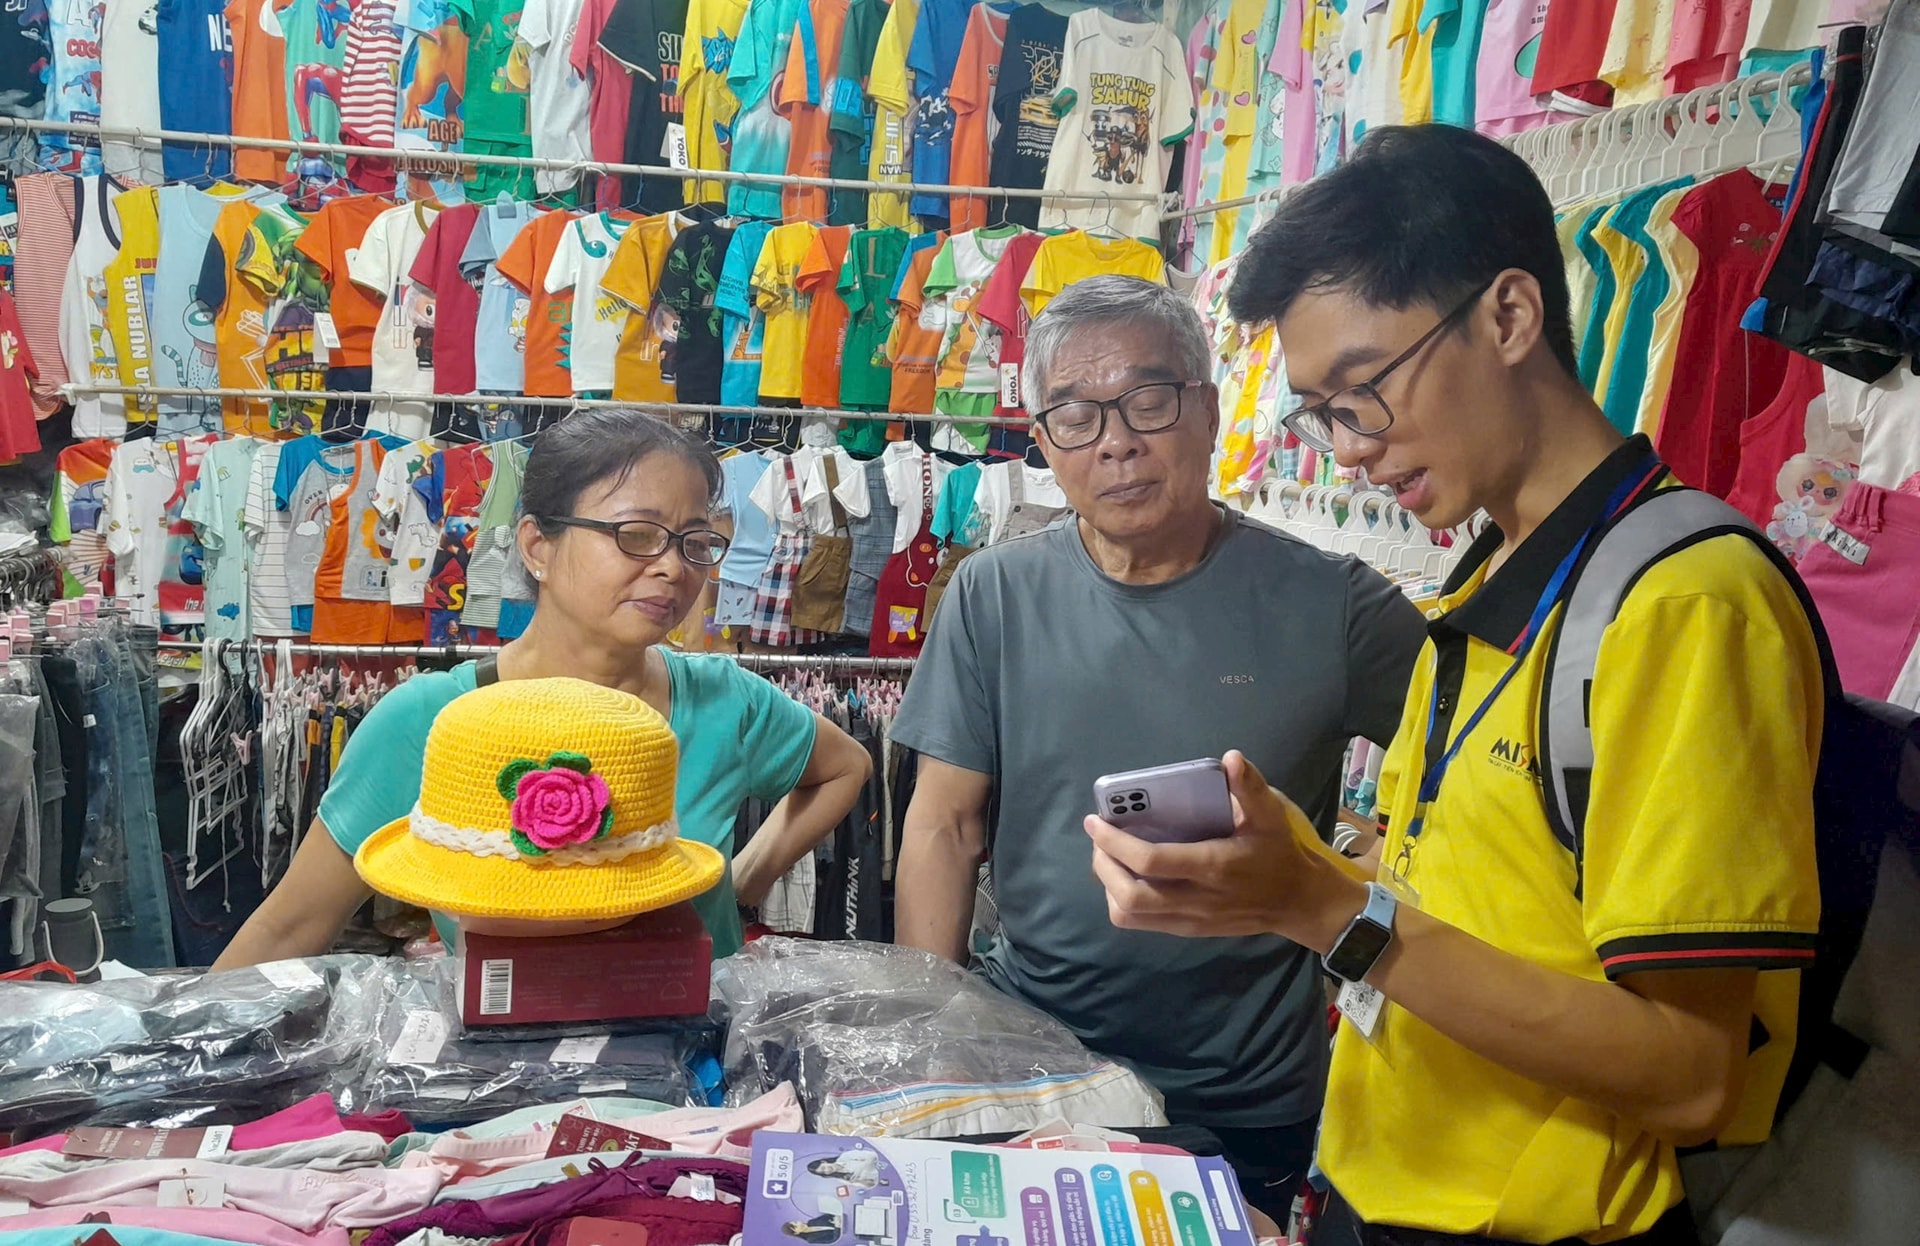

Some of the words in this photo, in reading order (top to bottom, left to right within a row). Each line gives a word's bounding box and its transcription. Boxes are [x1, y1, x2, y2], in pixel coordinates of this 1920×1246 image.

[1090, 73, 1122, 88] TUNG
[1124, 76, 1155, 97] TUNG
[1092, 87, 1150, 112] SAHUR
[428, 119, 457, 142] AGE
[677, 137, 686, 165] YOKO
[123, 276, 148, 361] NUBLAR
[1009, 374, 1018, 404] YOKO
[304, 489, 324, 505] OVER
[1219, 674, 1255, 684] VESCA
[778, 1155, 789, 1178] 5.0/5
